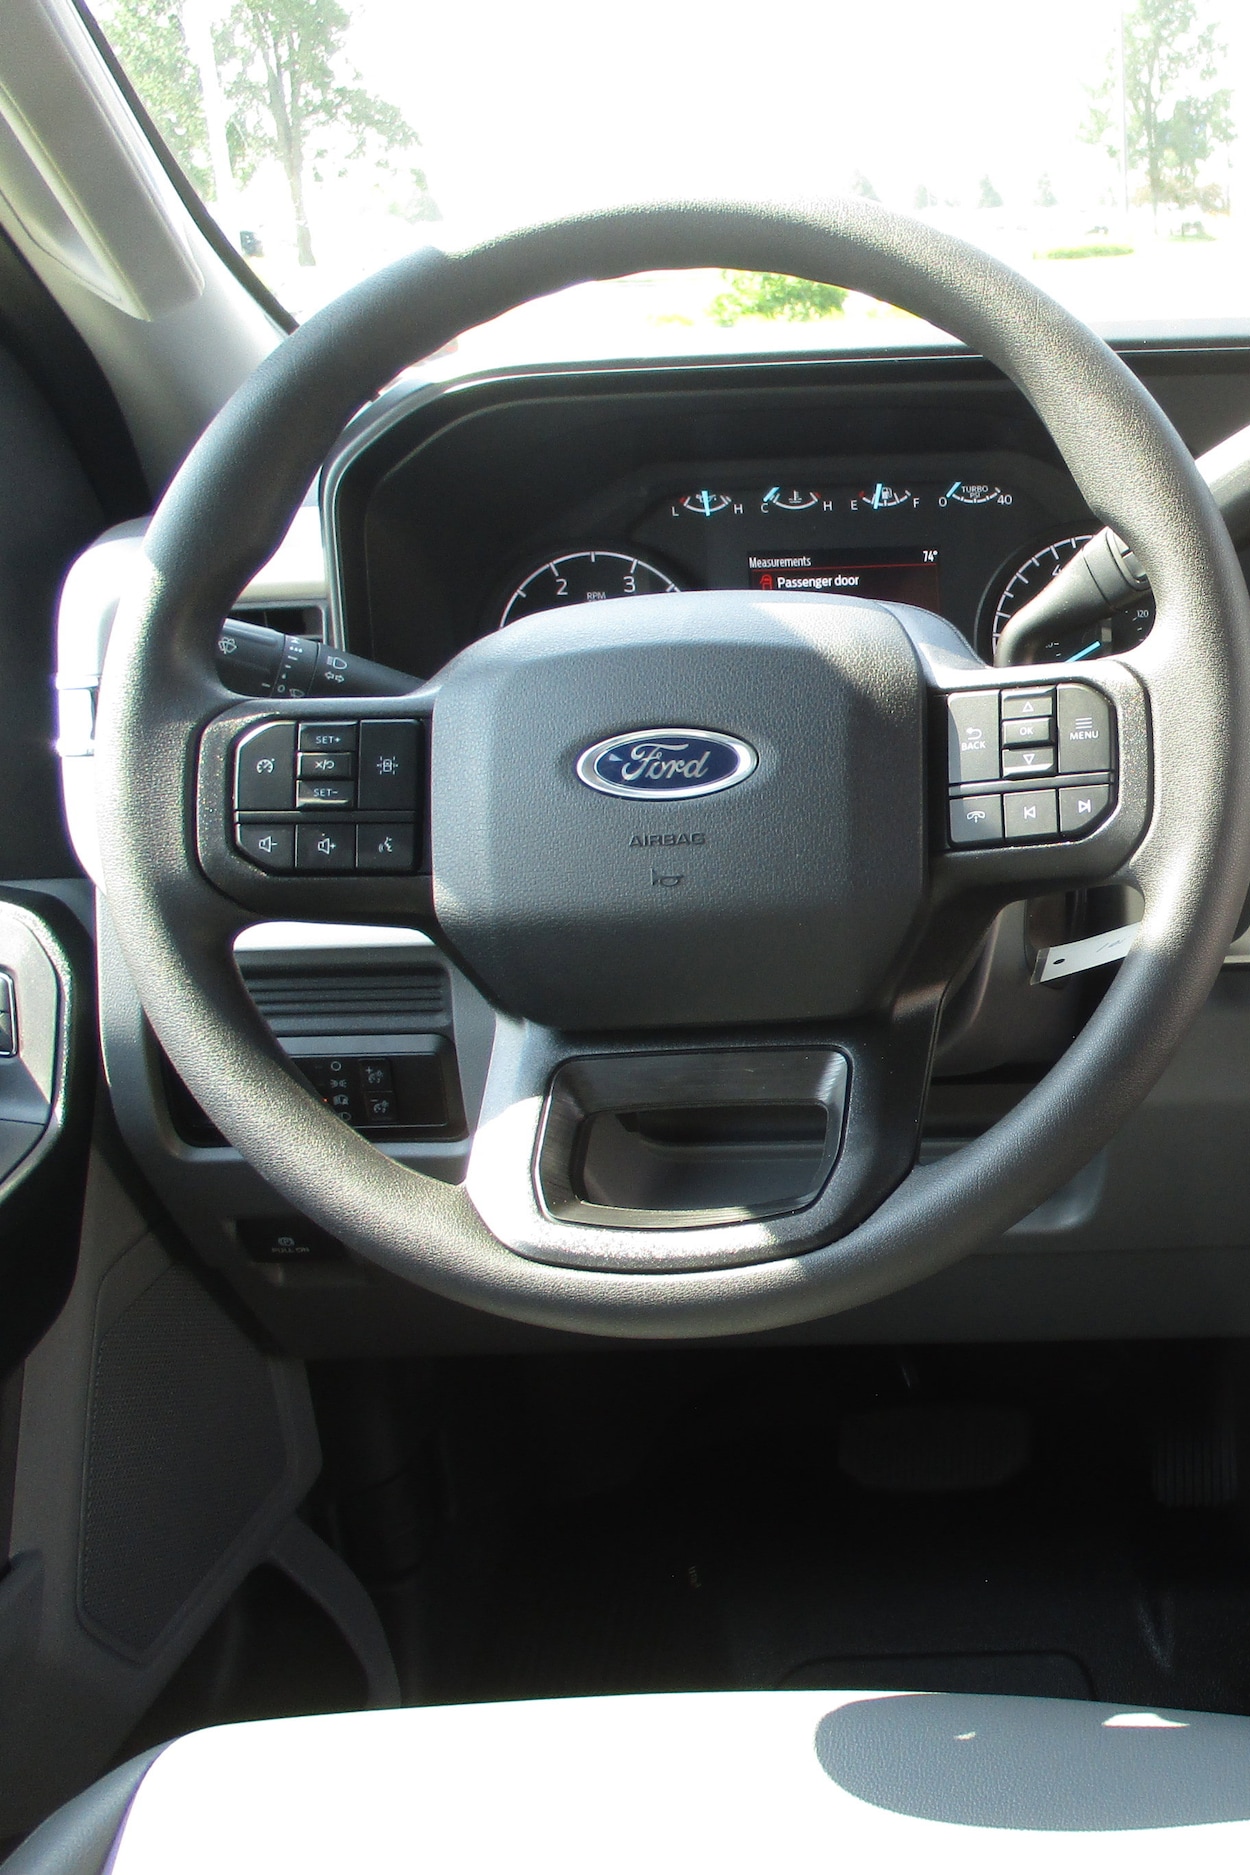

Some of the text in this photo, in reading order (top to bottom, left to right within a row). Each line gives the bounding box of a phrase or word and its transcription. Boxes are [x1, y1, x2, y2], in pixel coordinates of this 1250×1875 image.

[961, 485, 989, 493] TURBO
[913, 498, 920, 508] F
[996, 494, 1013, 505] 40
[733, 504, 744, 515] H
[760, 502, 769, 513] C
[823, 501, 833, 511] H
[850, 500, 858, 511] E
[671, 506, 680, 517] L
[749, 556, 812, 569] Measurements
[556, 579, 568, 595] 2
[623, 576, 636, 593] 3
[777, 574, 859, 590] Passenger door
[1137, 609, 1149, 618] 120
[1020, 727, 1034, 736] OK
[1069, 730, 1099, 740] MENU
[961, 741, 986, 752] BACK
[621, 743, 711, 781] Ford
[628, 833, 706, 848] AIRBAG
